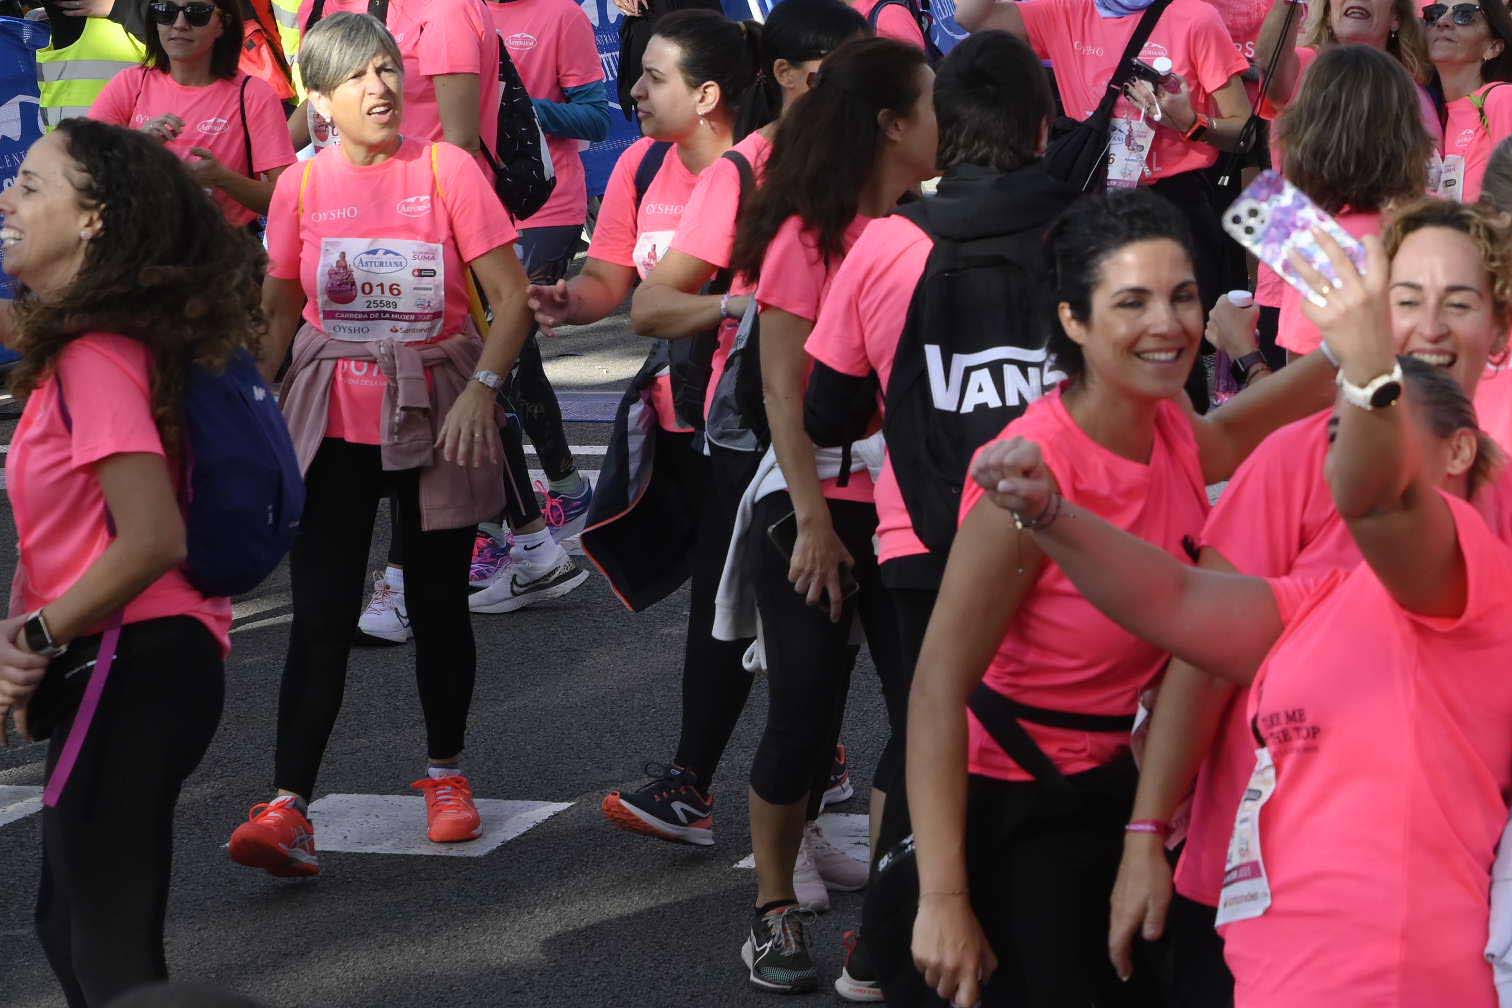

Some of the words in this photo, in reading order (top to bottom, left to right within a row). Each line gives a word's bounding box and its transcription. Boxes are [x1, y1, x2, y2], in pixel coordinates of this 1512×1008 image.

[311, 206, 358, 223] OYSHO
[358, 258, 403, 268] ASTURIANA
[361, 281, 402, 297] 016
[366, 299, 398, 309] 25589
[333, 325, 369, 334] OYSHO
[924, 344, 1068, 414] VANS
[1285, 709, 1306, 725] ME
